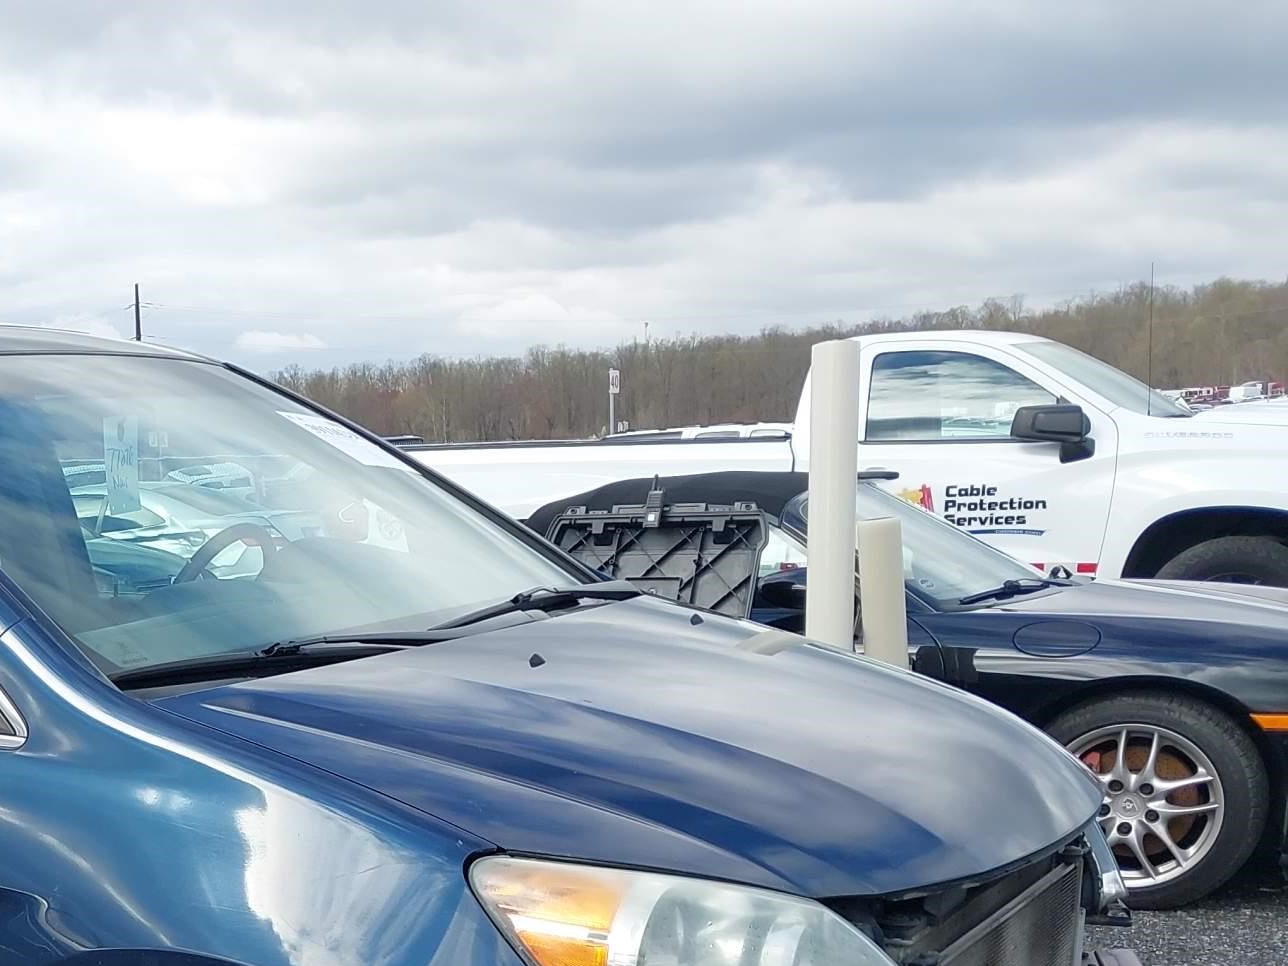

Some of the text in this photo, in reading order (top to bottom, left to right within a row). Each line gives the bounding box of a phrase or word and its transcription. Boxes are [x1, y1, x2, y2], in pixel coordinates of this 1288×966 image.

[945, 484, 997, 498] Cable
[943, 498, 1047, 512] Protection
[943, 513, 1026, 526] Services
